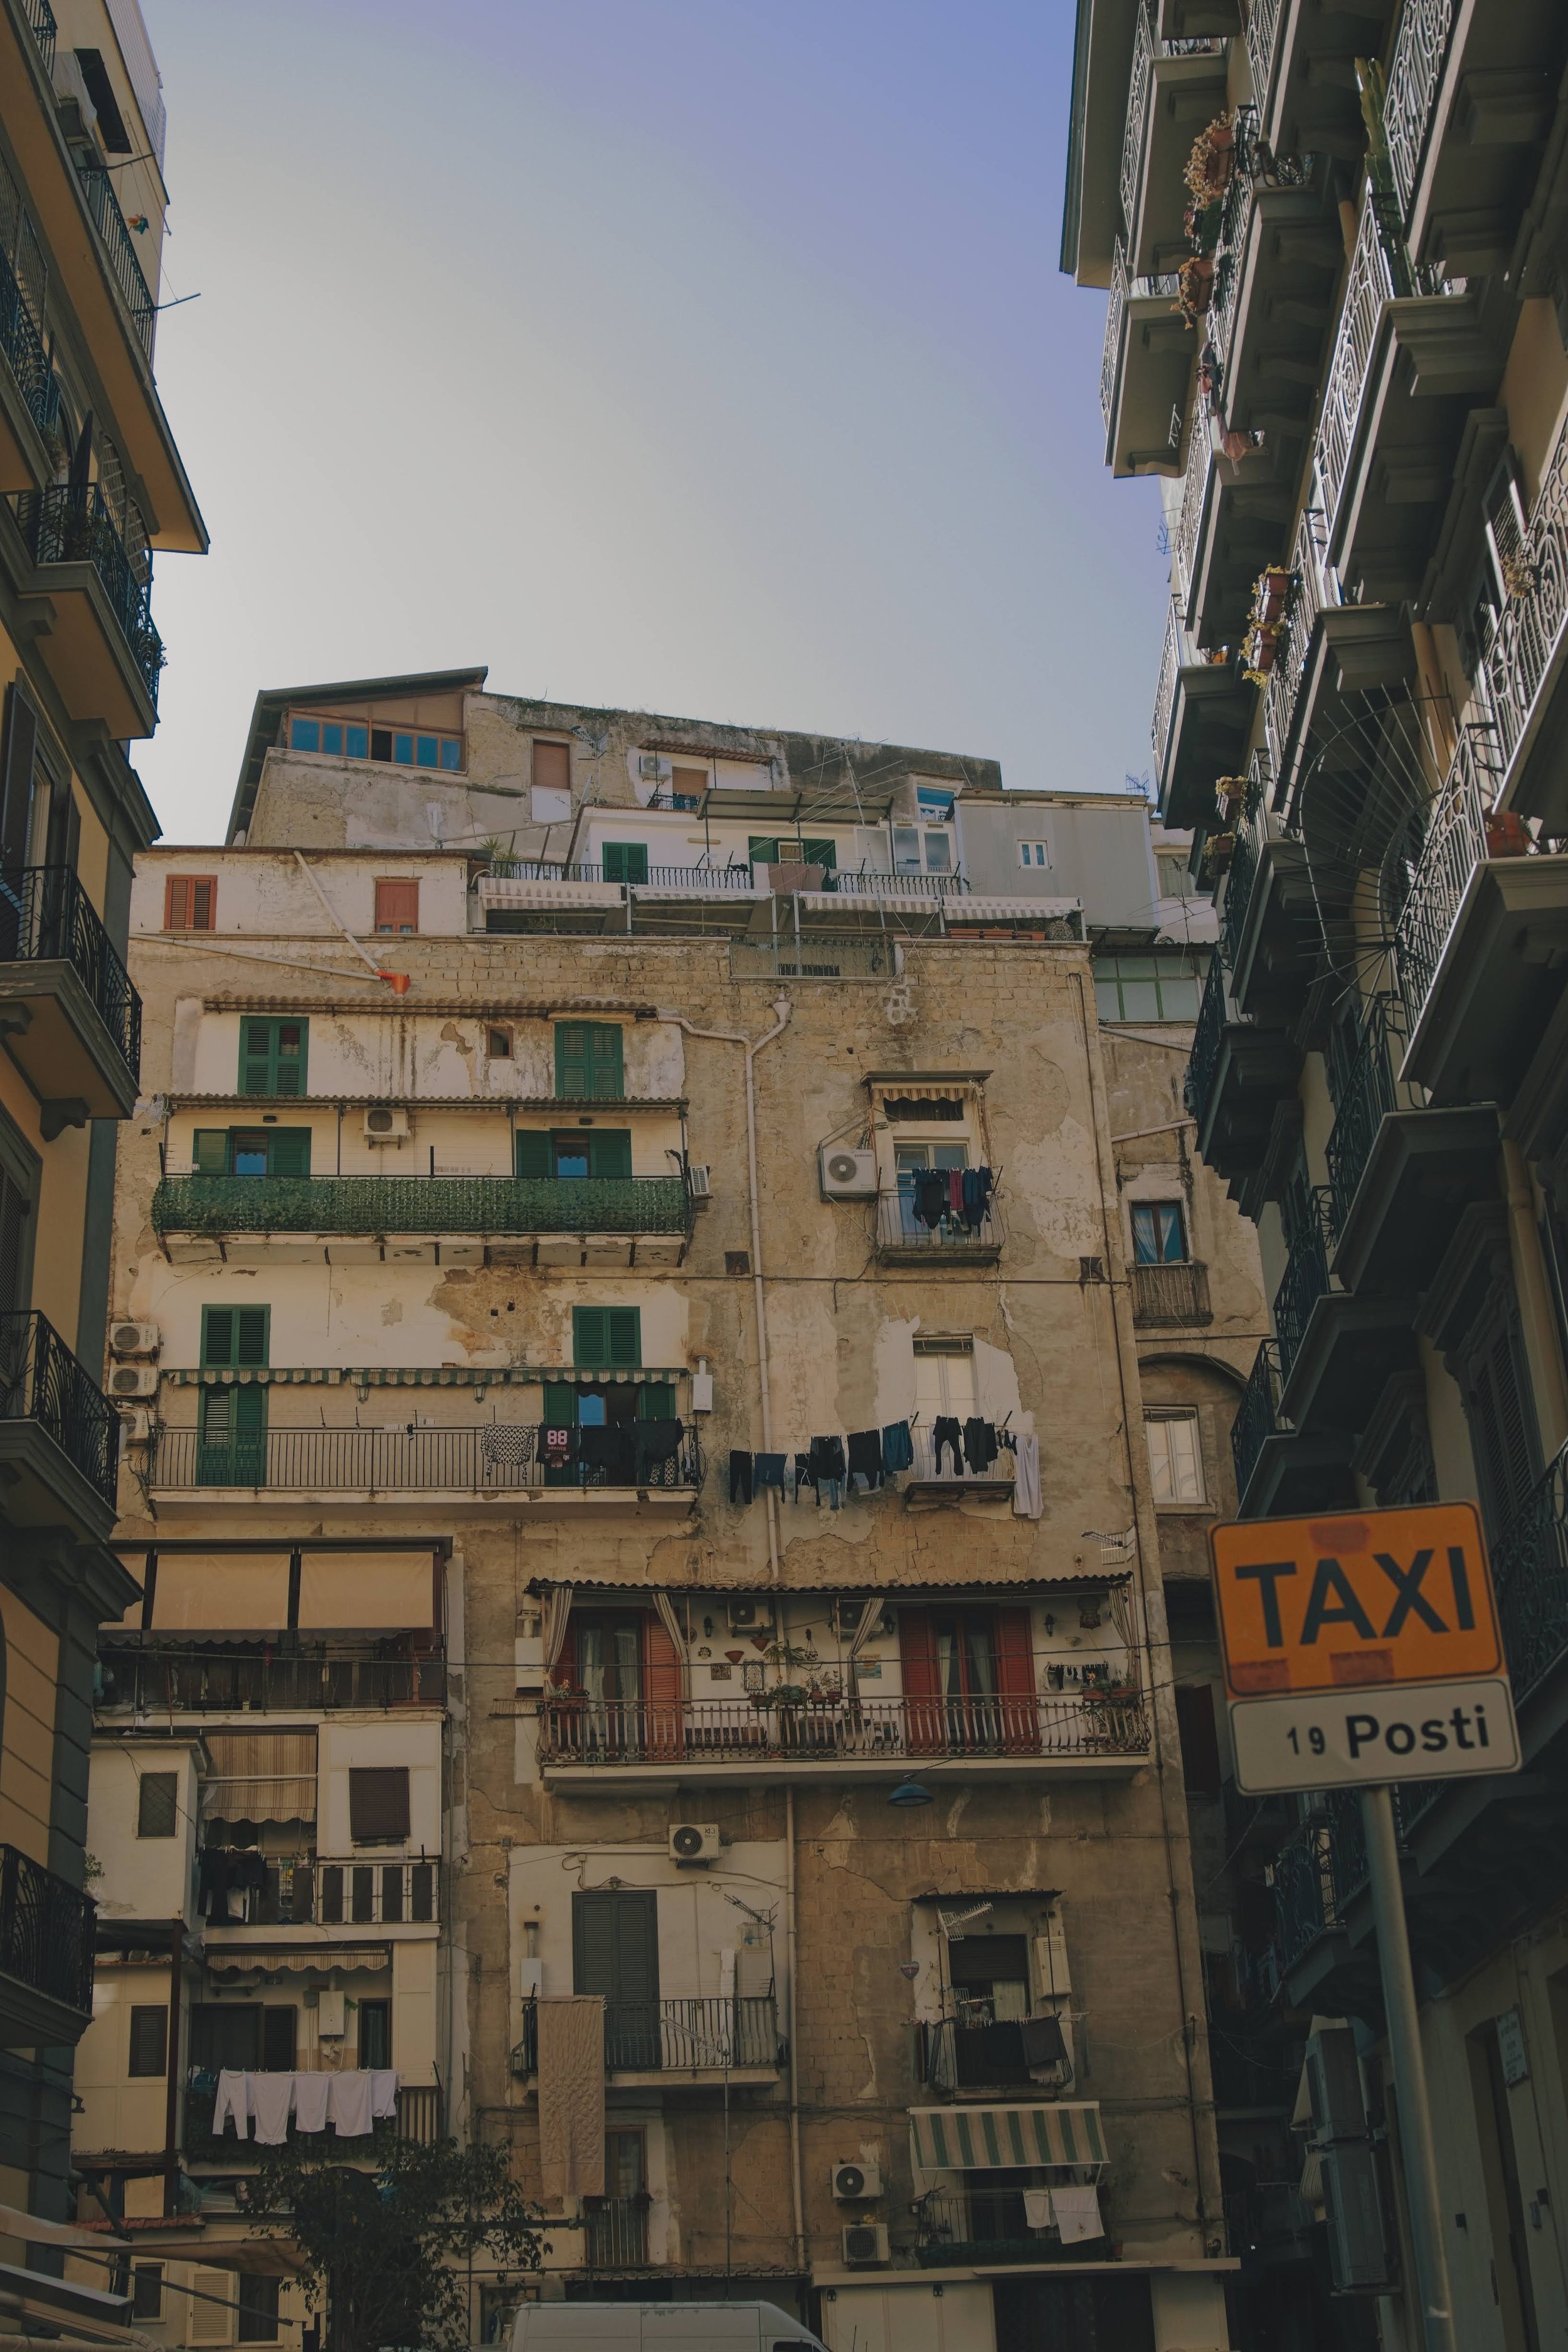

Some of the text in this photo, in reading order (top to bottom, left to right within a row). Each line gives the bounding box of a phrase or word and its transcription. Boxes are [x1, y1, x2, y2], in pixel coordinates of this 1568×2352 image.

[547, 1430, 568, 1445] 88
[1235, 1546, 1476, 1648] TAXI
[1286, 1705, 1490, 1759] 19 Posti
